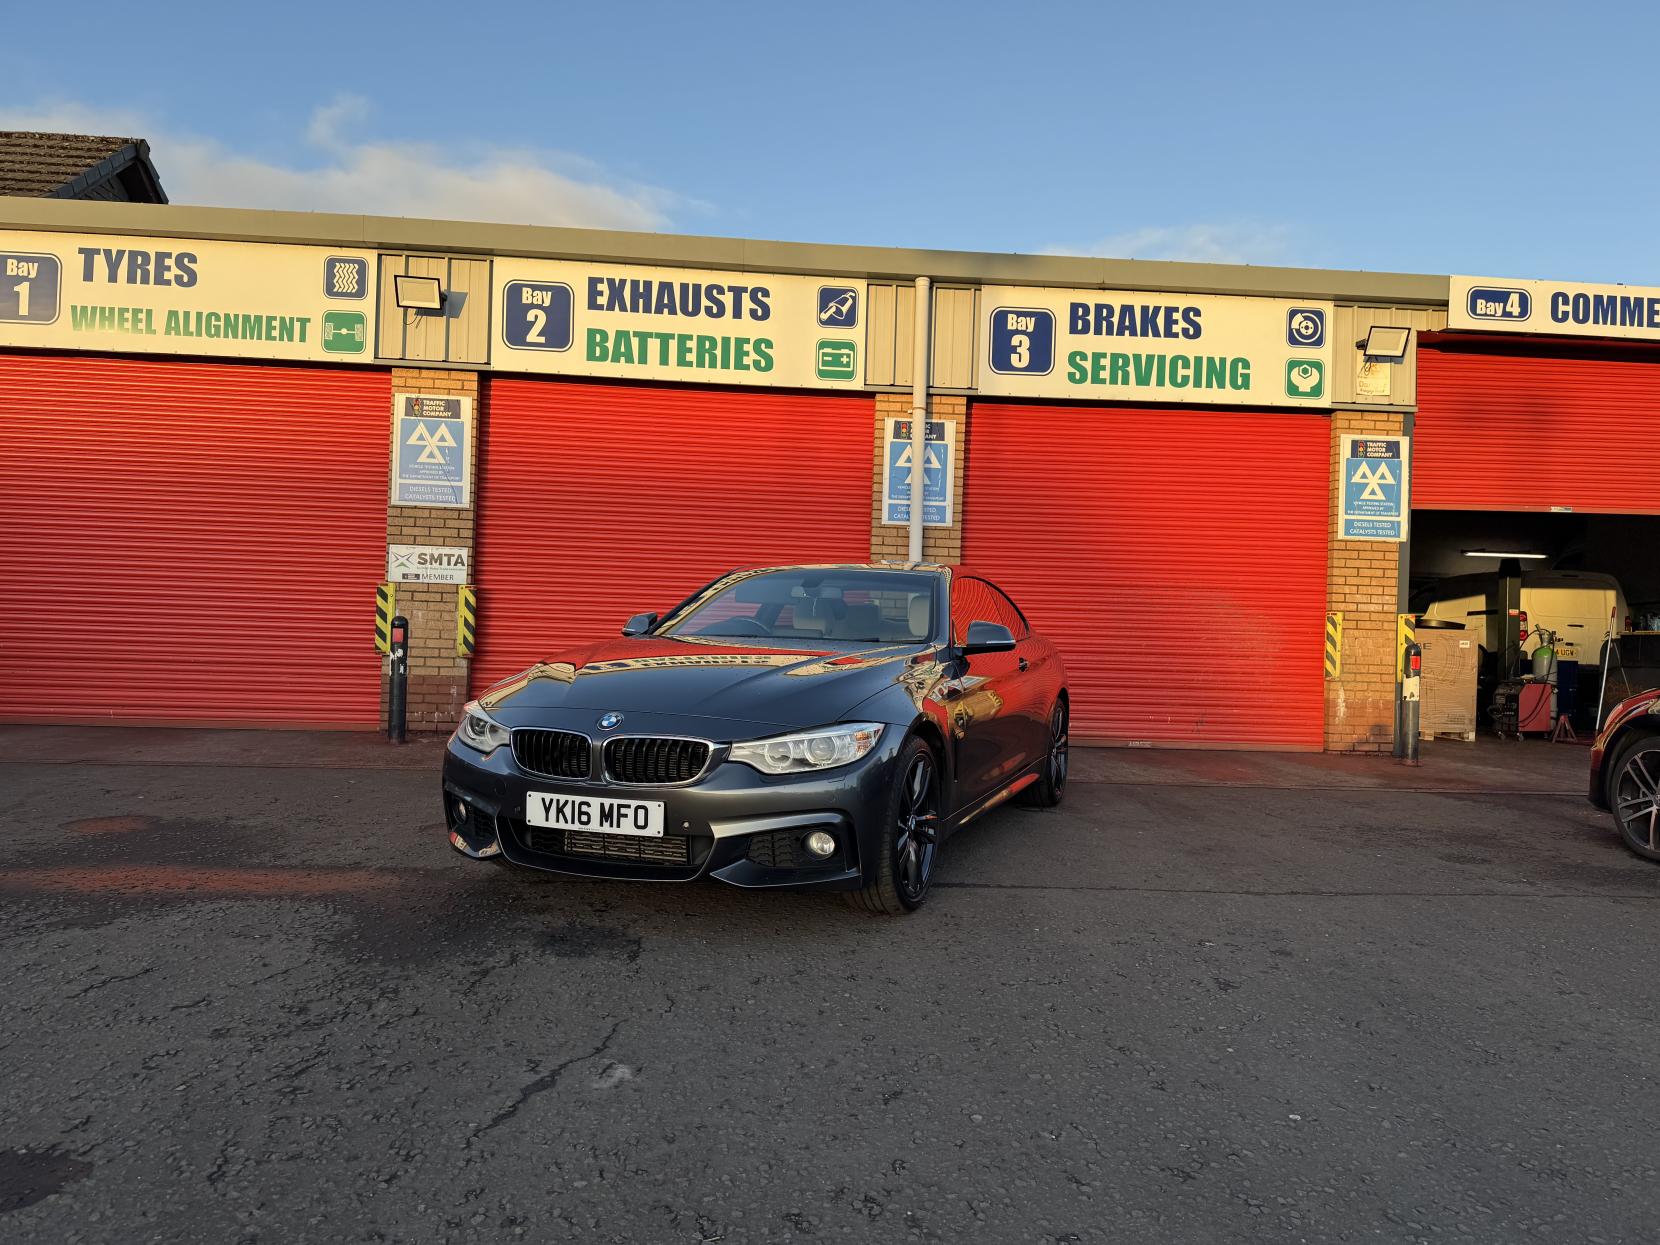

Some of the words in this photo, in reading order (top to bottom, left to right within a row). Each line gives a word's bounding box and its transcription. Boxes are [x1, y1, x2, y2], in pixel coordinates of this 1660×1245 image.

[6, 258, 38, 278] Bay
[78, 247, 198, 288] TYRES
[14, 282, 30, 316] 1
[521, 287, 552, 306] Bay
[587, 276, 771, 322] EXHAUSTS
[1476, 298, 1504, 316] Bay
[1505, 292, 1521, 316] 4
[1550, 291, 1660, 328] COMME
[70, 304, 156, 336] WHEEL
[164, 309, 312, 344] ALIGNMENT
[526, 309, 547, 344] 2
[1007, 314, 1035, 332] Bay
[1069, 302, 1202, 340] BRAKES
[586, 328, 774, 372] BATTERIES
[1010, 334, 1030, 368] 3
[1067, 350, 1251, 390] SERVICING
[417, 552, 466, 566] SMTA
[541, 797, 592, 826] YK16
[600, 802, 648, 830] MFO
